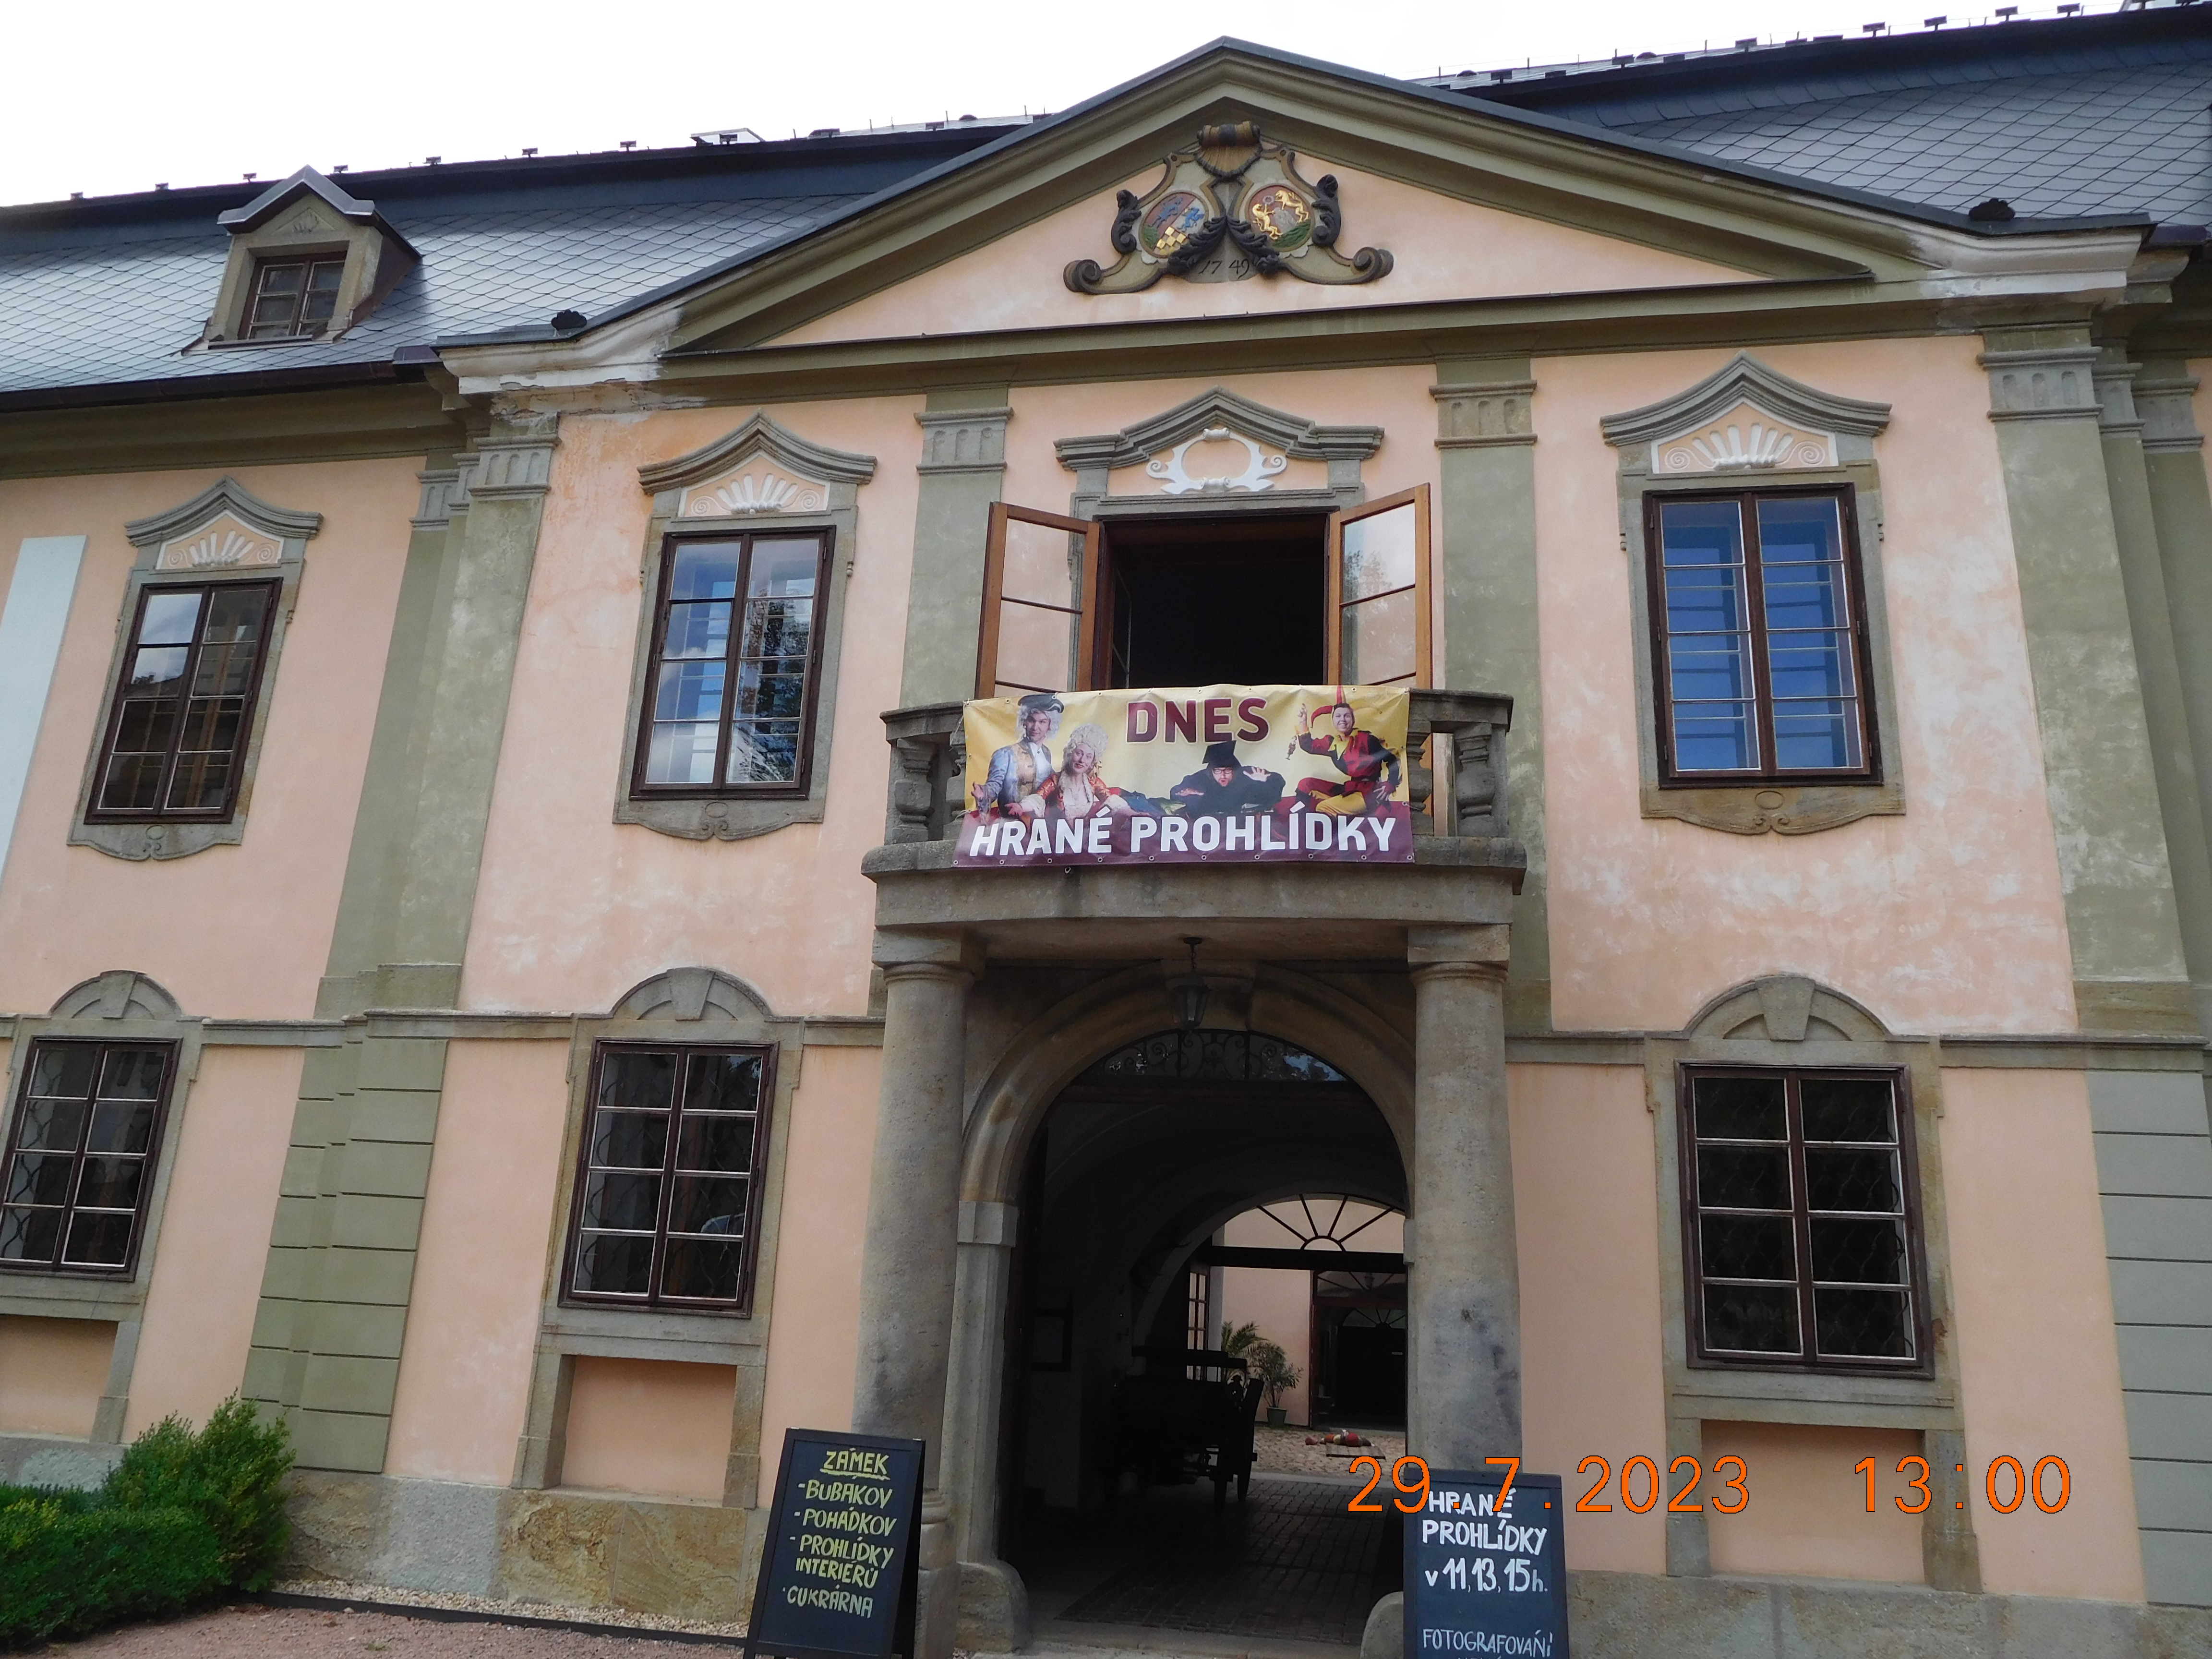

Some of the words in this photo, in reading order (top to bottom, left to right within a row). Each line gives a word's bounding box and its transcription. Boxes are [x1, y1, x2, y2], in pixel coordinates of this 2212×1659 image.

[1126, 698, 1269, 744] DNES
[969, 805, 1113, 857] HRANÉ
[1130, 802, 1396, 853] PROHLÍDKY
[823, 1447, 890, 1475] ZÁMEK
[1422, 1519, 1547, 1556] PROHLÍDKY
[795, 1557, 878, 1589] INTERIÉRŮ
[787, 1584, 874, 1619] CUKRÁRNA
